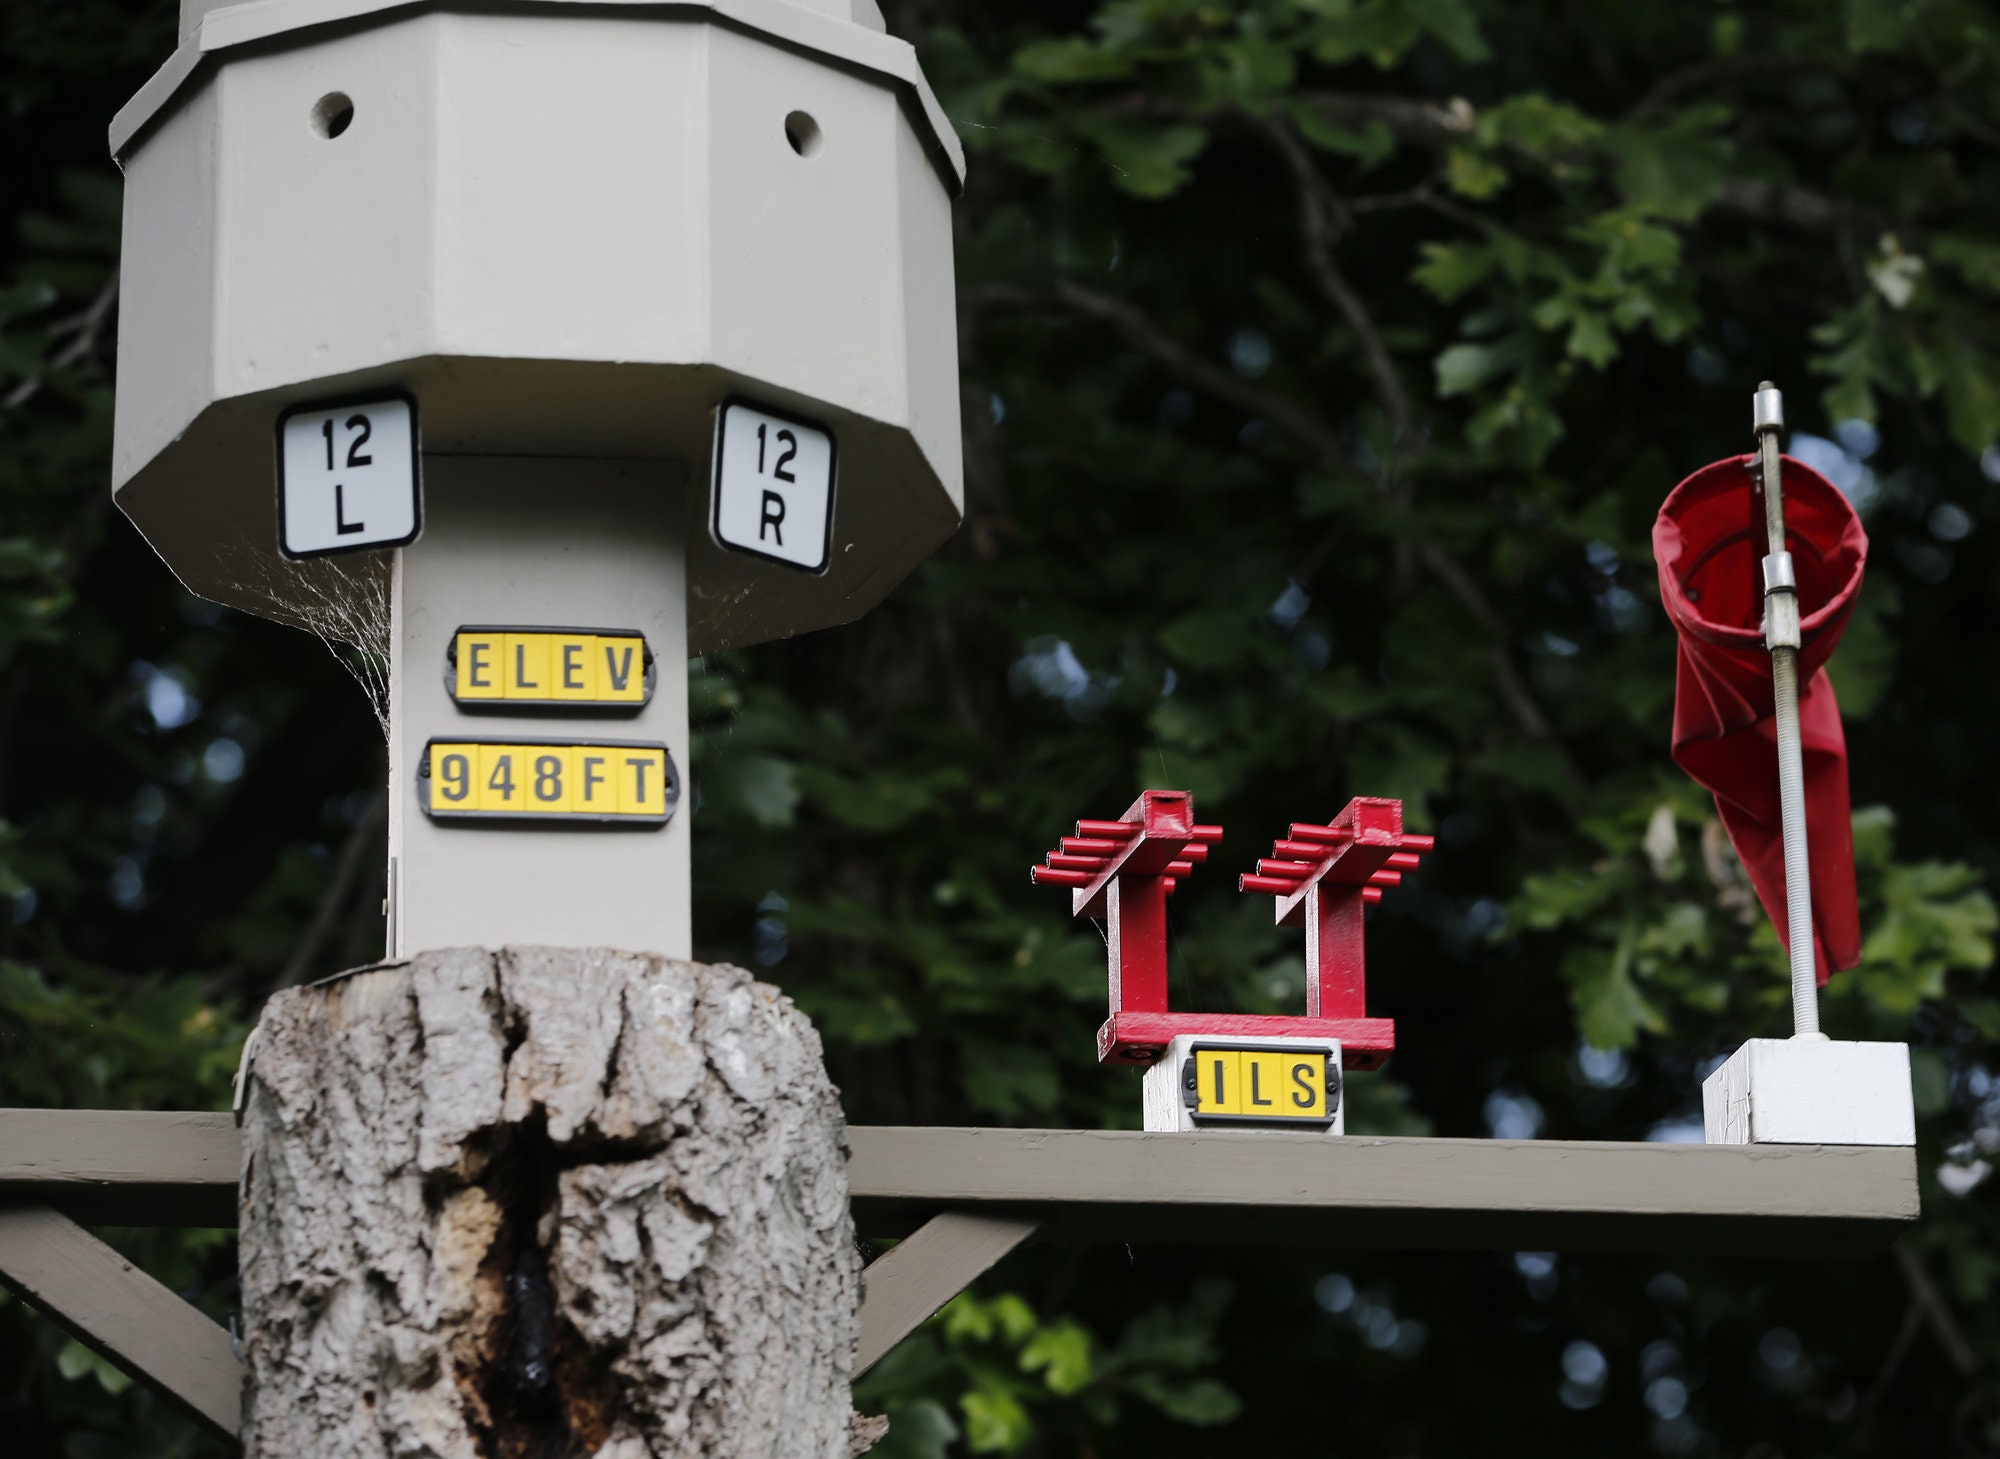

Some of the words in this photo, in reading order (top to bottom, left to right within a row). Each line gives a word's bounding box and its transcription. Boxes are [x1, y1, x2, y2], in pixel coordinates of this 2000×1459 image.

[322, 414, 373, 471] 12
[757, 422, 798, 484] 12
[335, 484, 365, 536] L
[759, 488, 786, 547] R
[470, 643, 633, 691] ELEV
[1213, 1059, 1316, 1109] ILS
